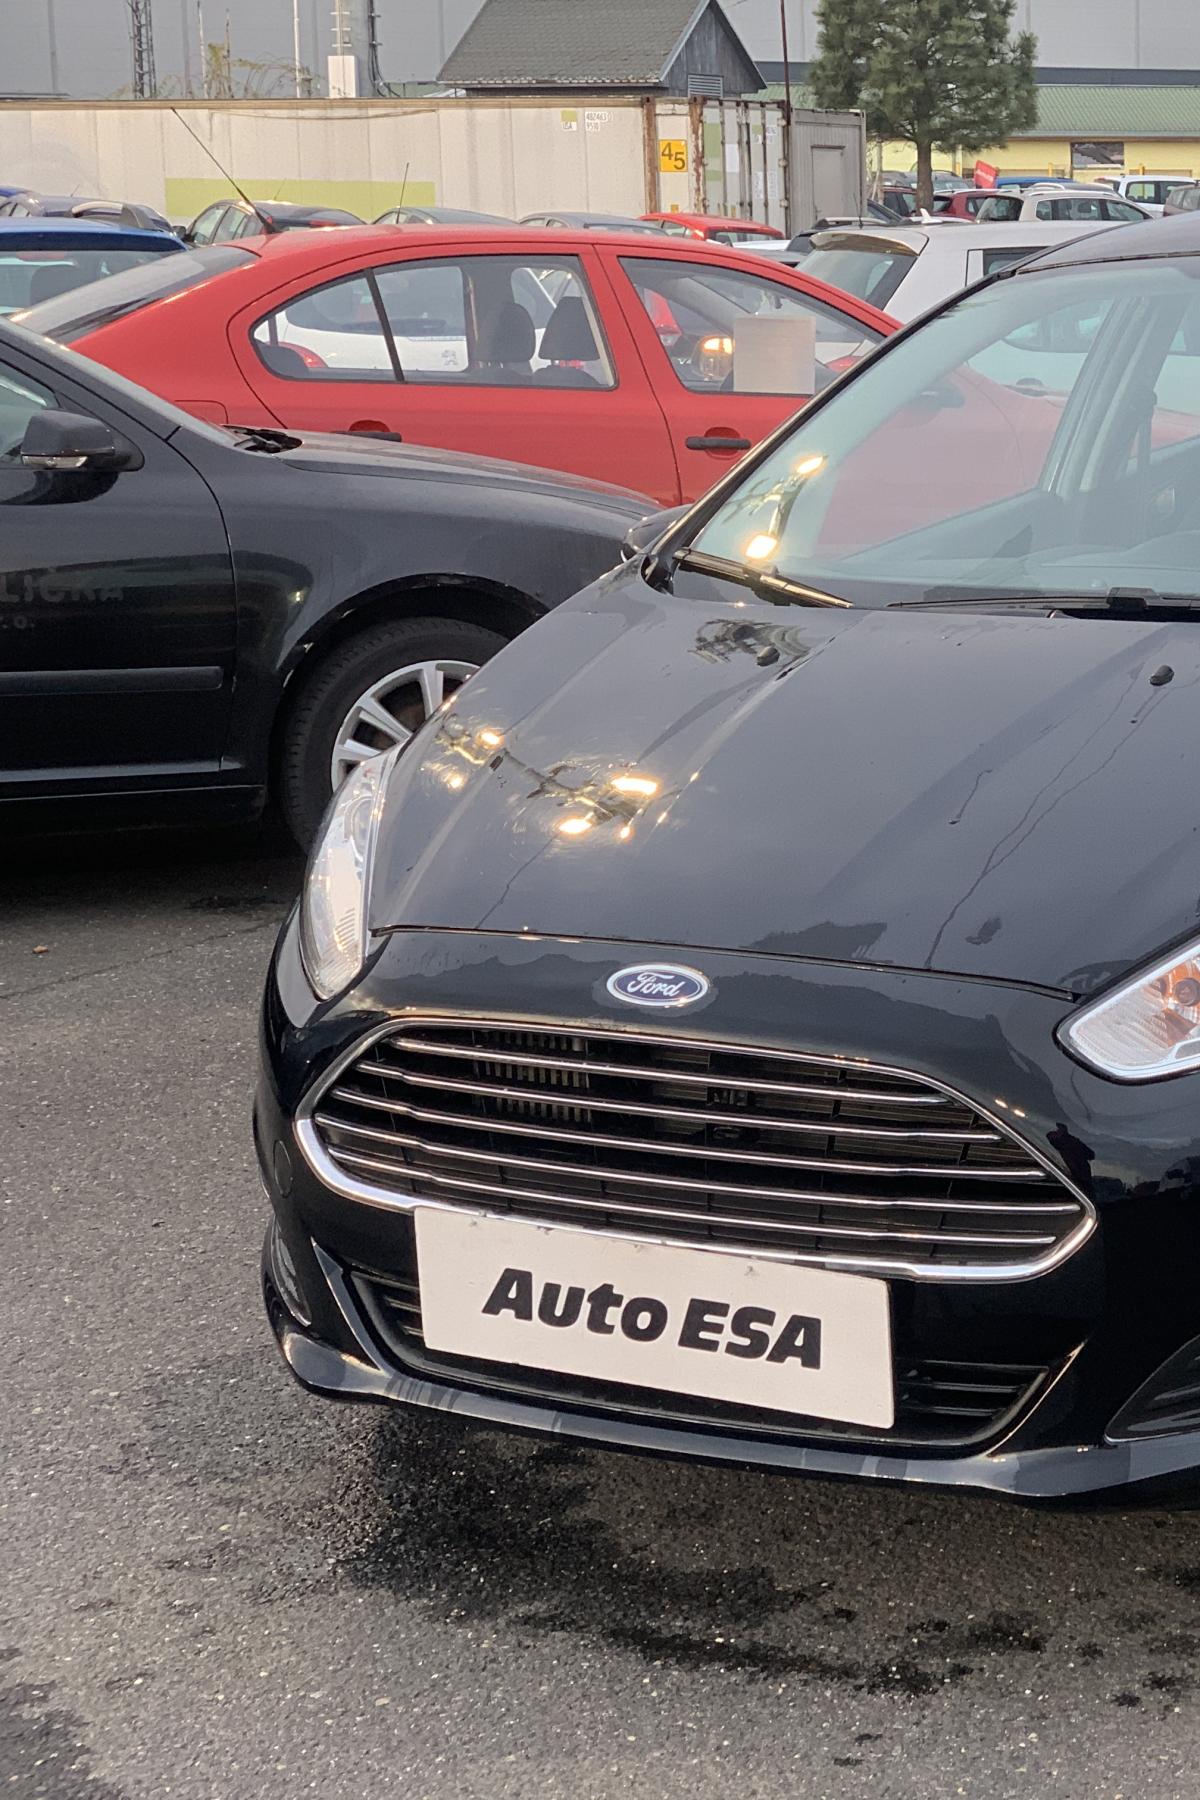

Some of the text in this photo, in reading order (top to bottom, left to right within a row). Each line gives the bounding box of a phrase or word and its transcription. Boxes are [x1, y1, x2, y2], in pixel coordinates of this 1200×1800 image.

[626, 971, 686, 997] Ford
[481, 1267, 822, 1371] Auto ESA
